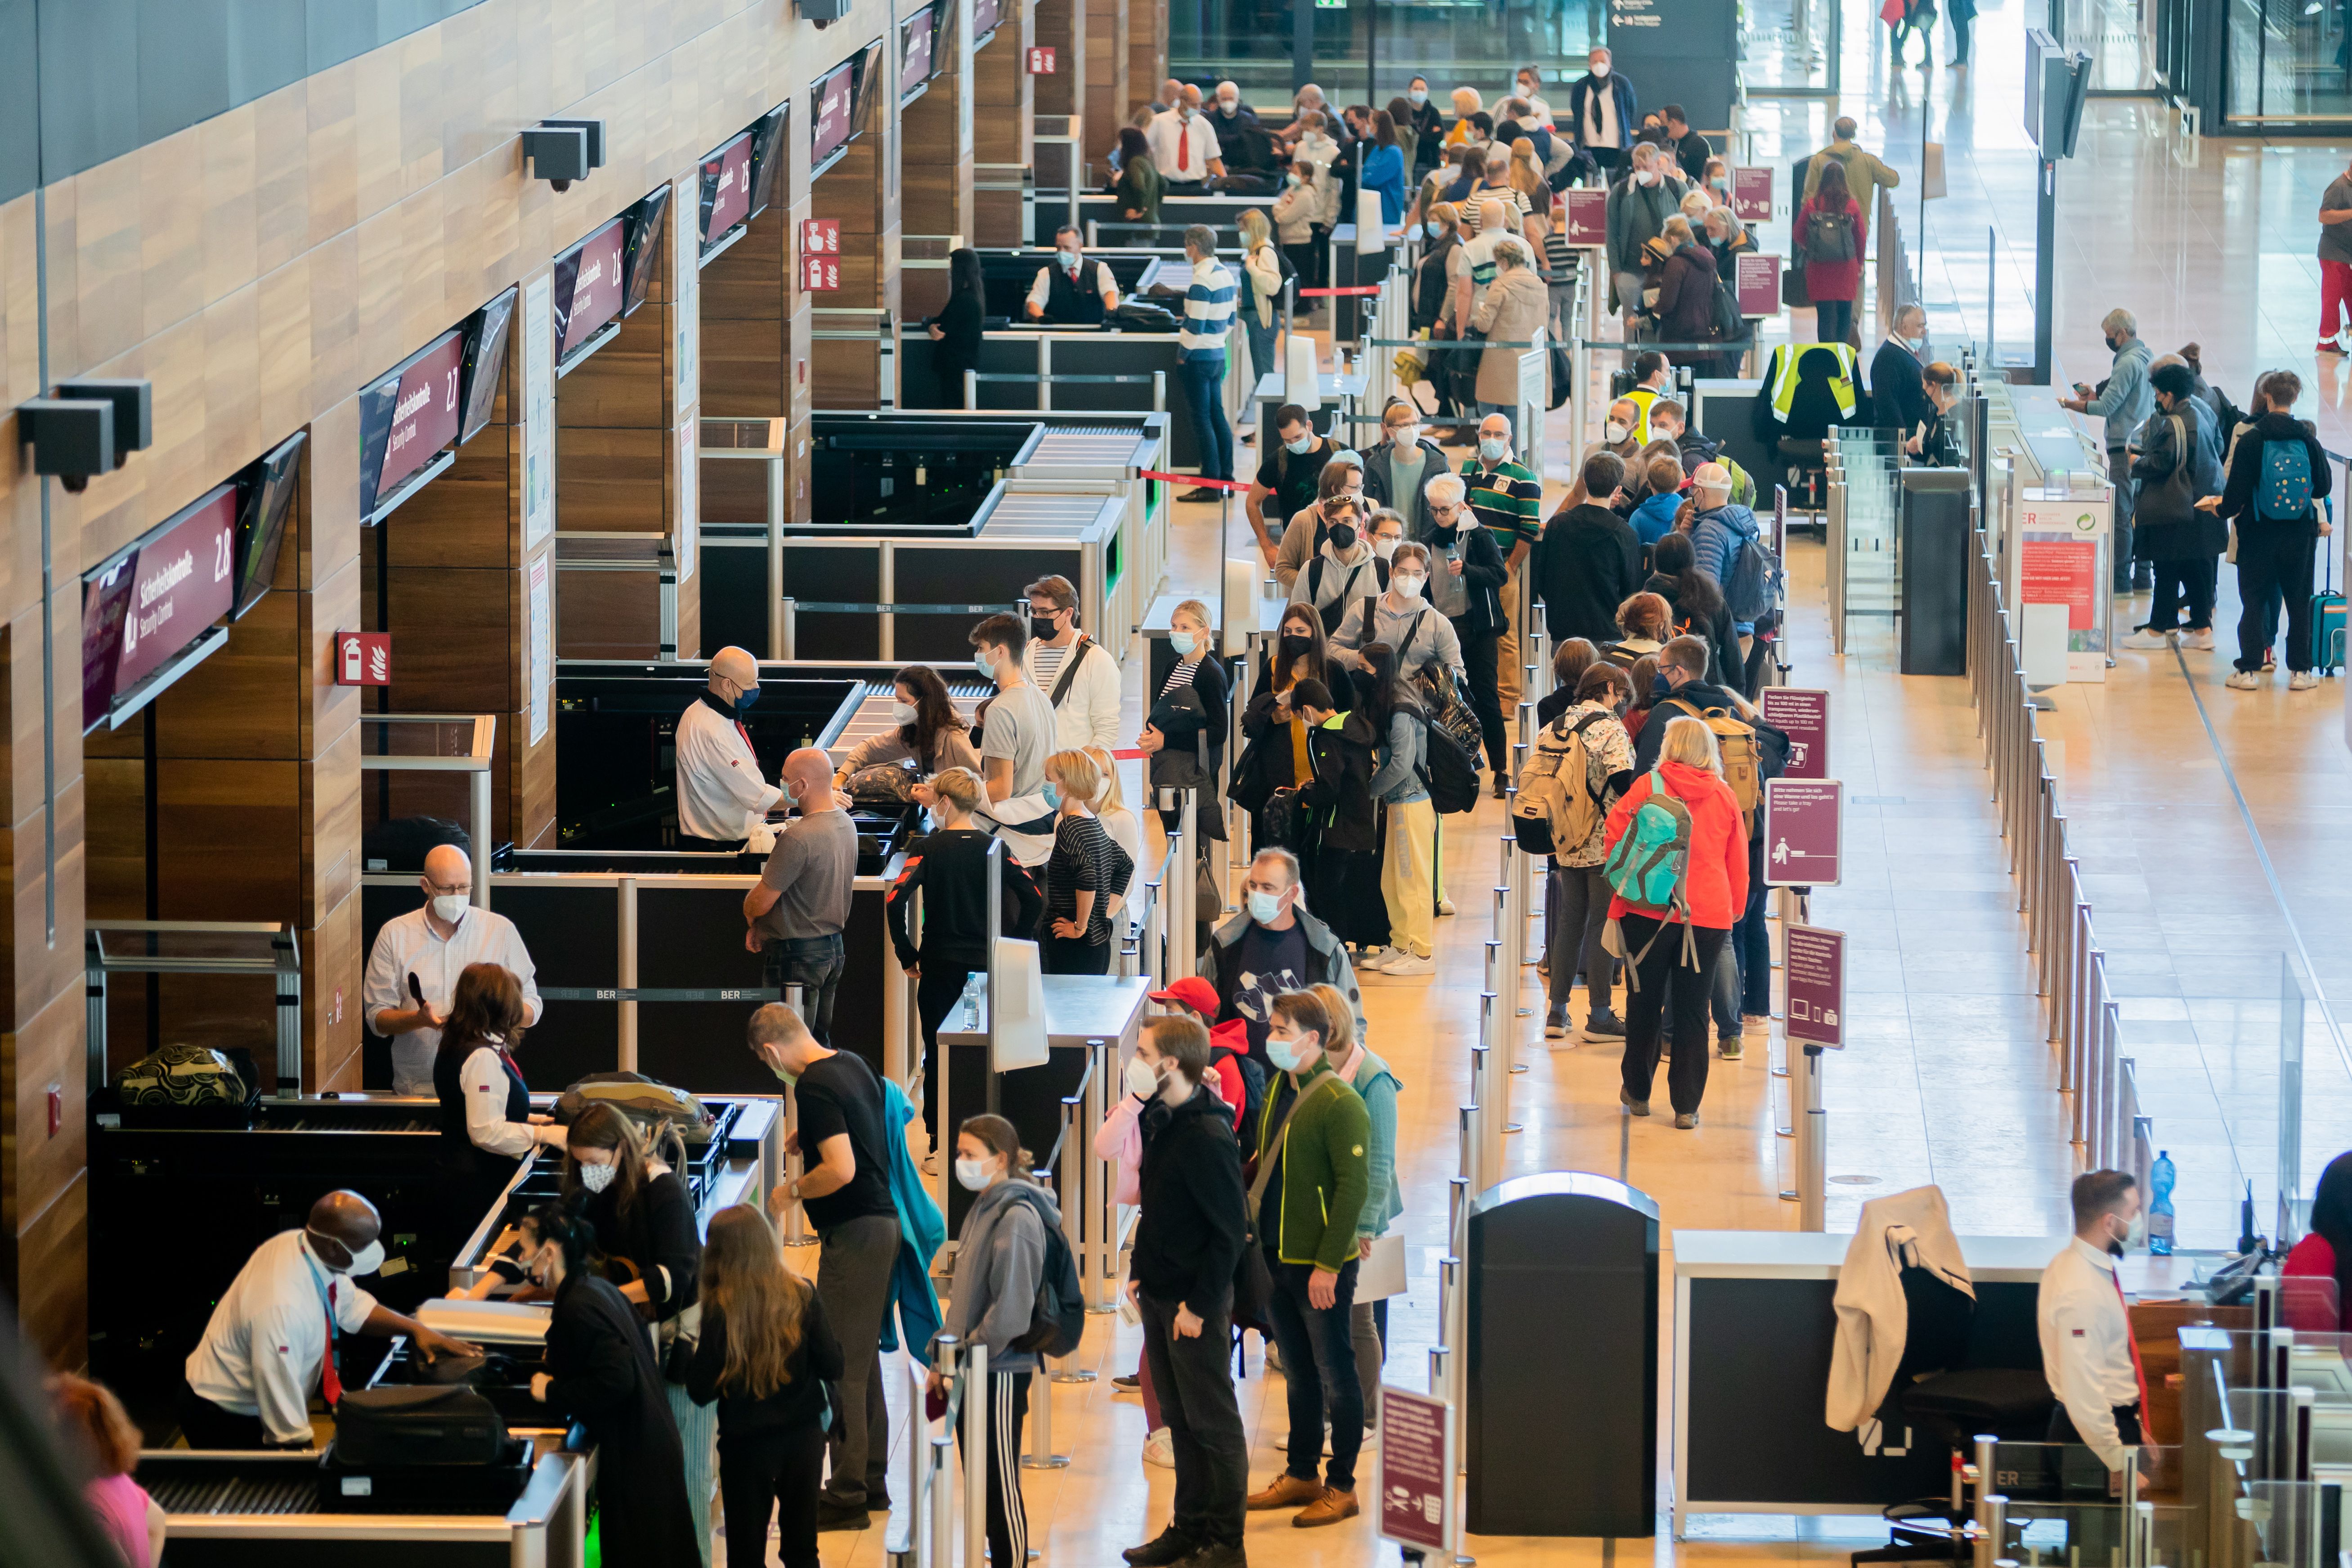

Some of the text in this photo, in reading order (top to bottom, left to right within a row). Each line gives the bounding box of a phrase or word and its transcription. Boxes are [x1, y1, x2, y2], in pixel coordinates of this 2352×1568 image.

[741, 159, 749, 193] 2.5
[613, 248, 621, 287] 2.6
[574, 290, 591, 316] Security Control
[447, 367, 458, 412] 2.7
[393, 419, 416, 451] Security Control
[2022, 512, 2036, 524] ER
[215, 527, 231, 582] 2.8
[140, 549, 193, 609] Sicherheitskontrolle
[140, 596, 173, 639] Security Control
[597, 990, 616, 999] BER
[721, 990, 740, 999] BER
[1997, 1471, 2018, 1485] ER
